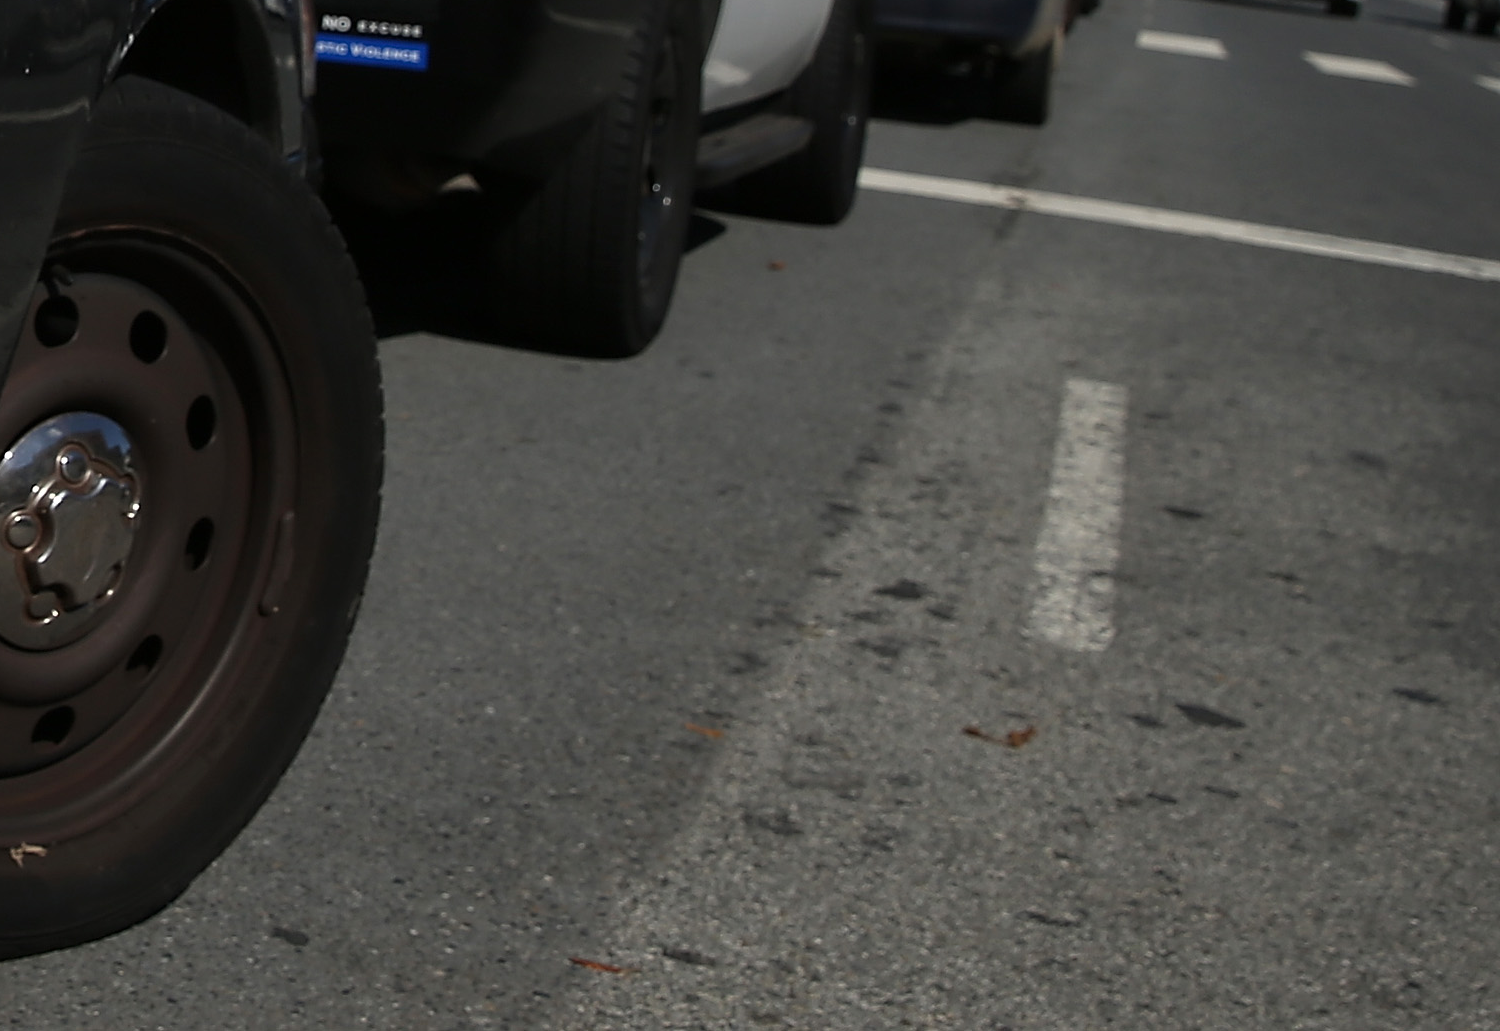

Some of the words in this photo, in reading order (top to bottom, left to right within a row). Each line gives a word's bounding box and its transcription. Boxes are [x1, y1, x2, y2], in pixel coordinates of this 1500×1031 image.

[322, 14, 351, 33] NO
[357, 19, 422, 38] EXCUSE
[350, 42, 420, 63] VIOLENCE
